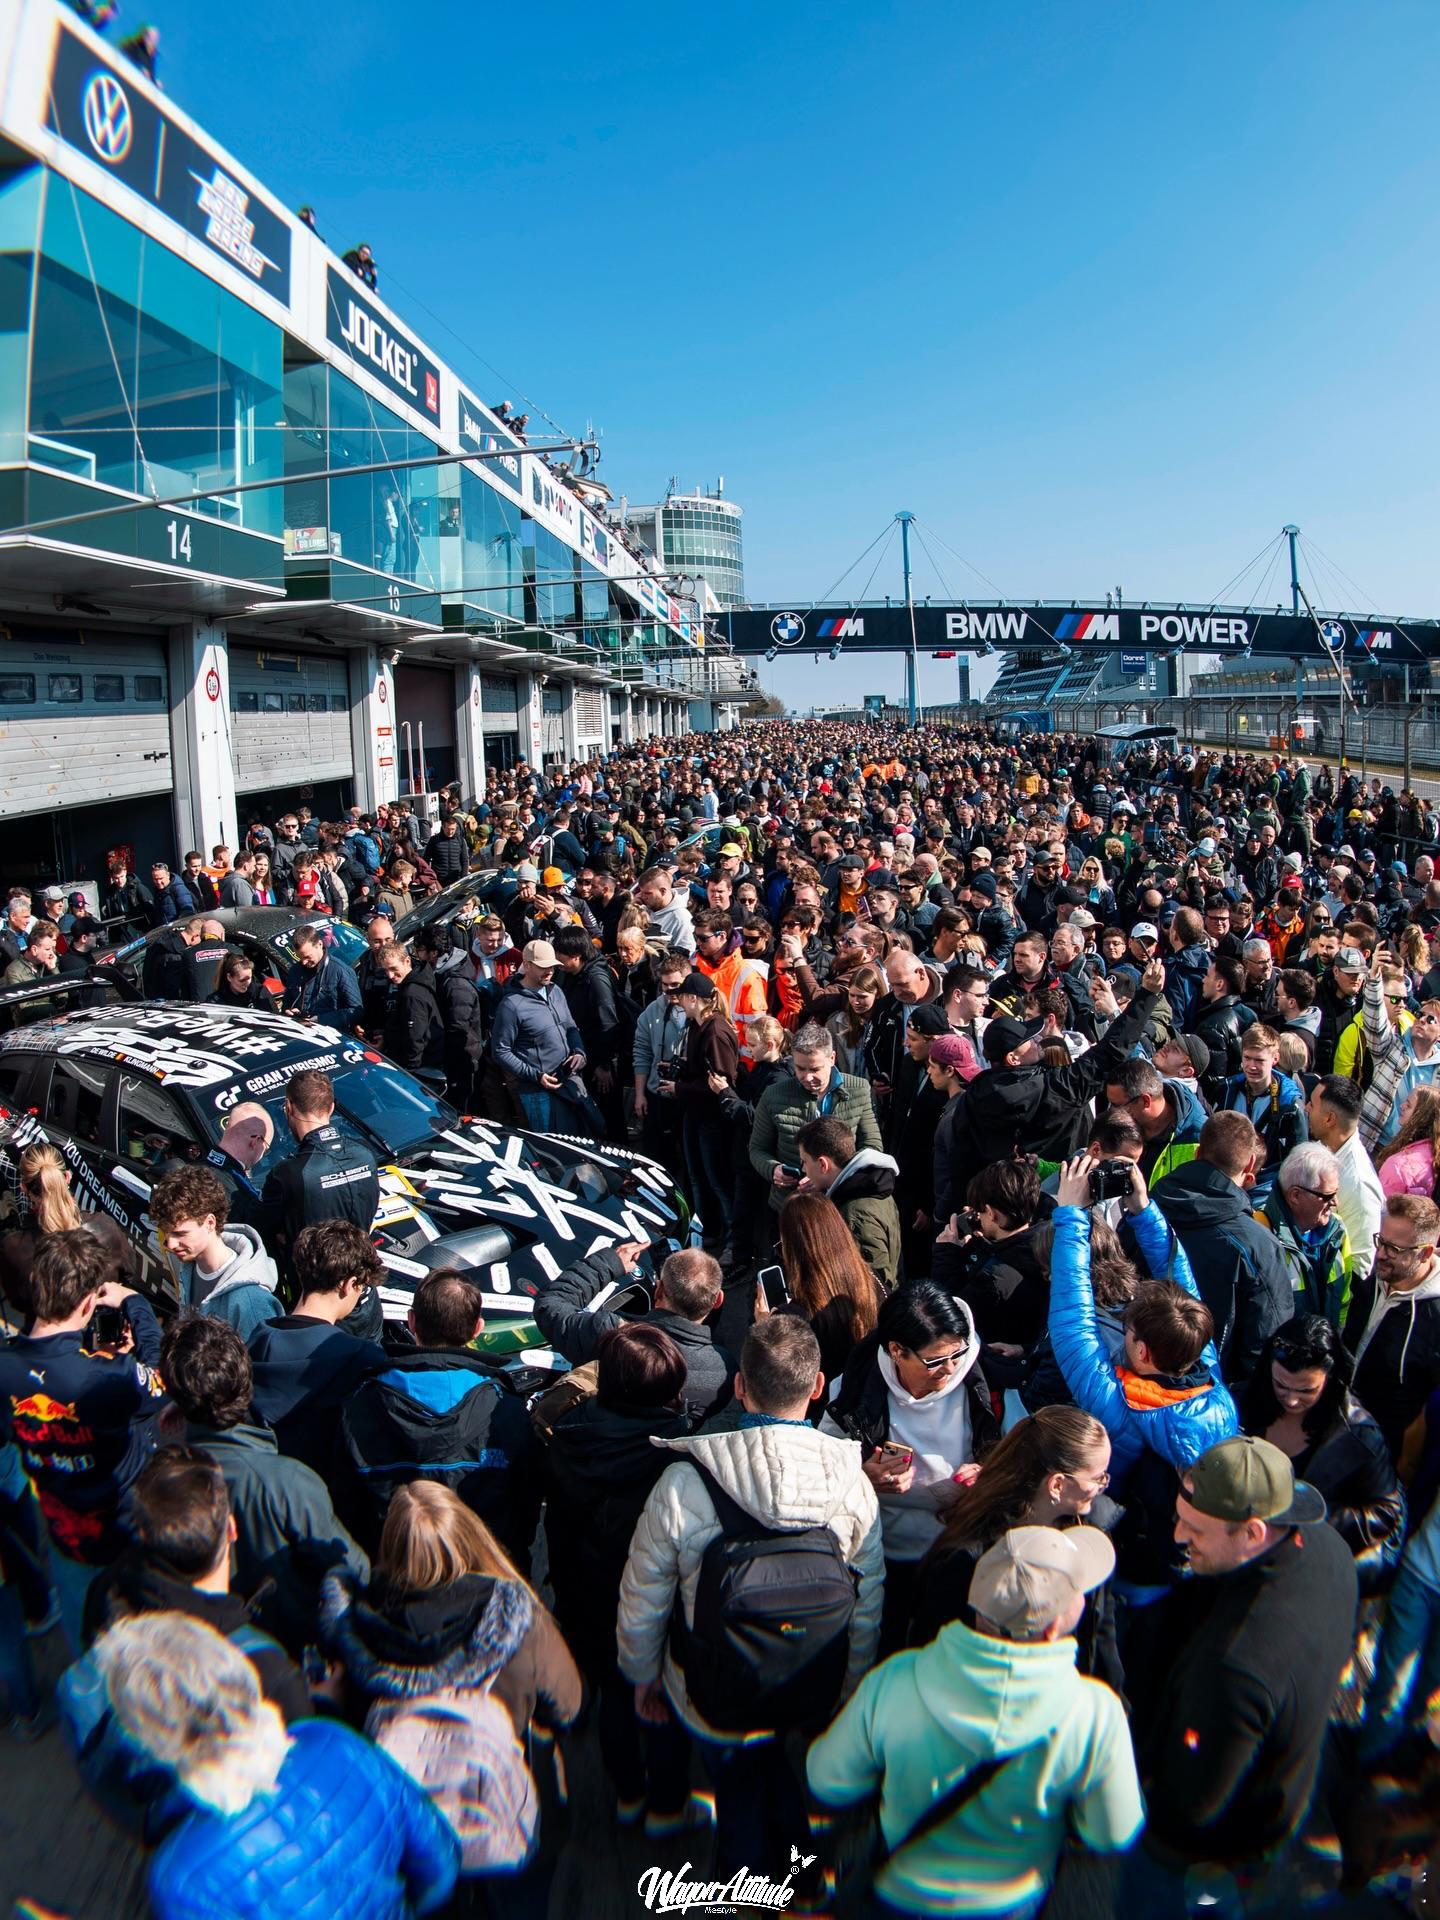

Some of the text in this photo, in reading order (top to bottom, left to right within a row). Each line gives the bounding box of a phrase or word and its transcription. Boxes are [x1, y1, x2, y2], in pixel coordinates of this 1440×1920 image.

[341, 299, 418, 397] JOCKEL
[167, 520, 192, 563] 14
[388, 584, 400, 612] 13
[946, 613, 1028, 640] BMW
[1081, 614, 1120, 641] M
[1140, 615, 1250, 645] POWER
[123, 1056, 160, 1075] KLINGMANN
[245, 1069, 284, 1093] GRAN
[62, 1136, 83, 1168] YOU
[79, 1160, 129, 1228] DREAMED
[130, 1221, 144, 1244] IT.
